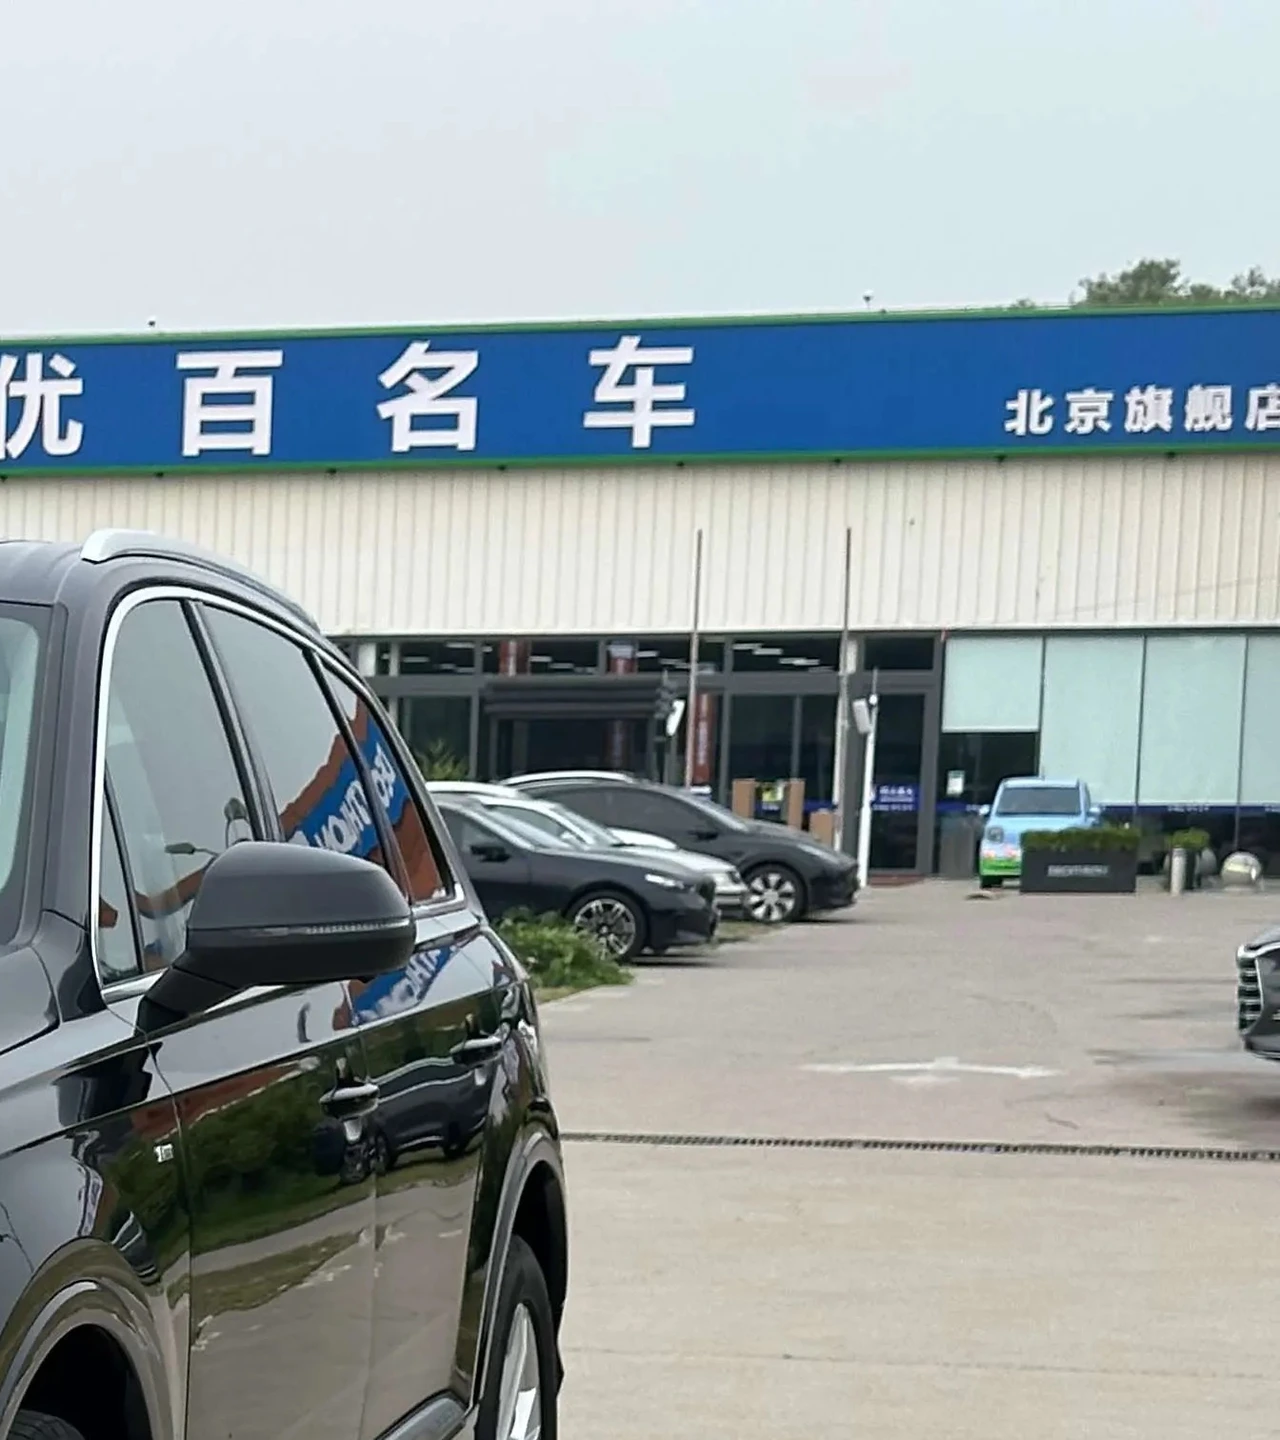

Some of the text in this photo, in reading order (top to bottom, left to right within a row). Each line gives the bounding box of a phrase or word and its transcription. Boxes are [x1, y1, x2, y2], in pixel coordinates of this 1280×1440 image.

[1004, 383, 1280, 436] 北京旗舰店
